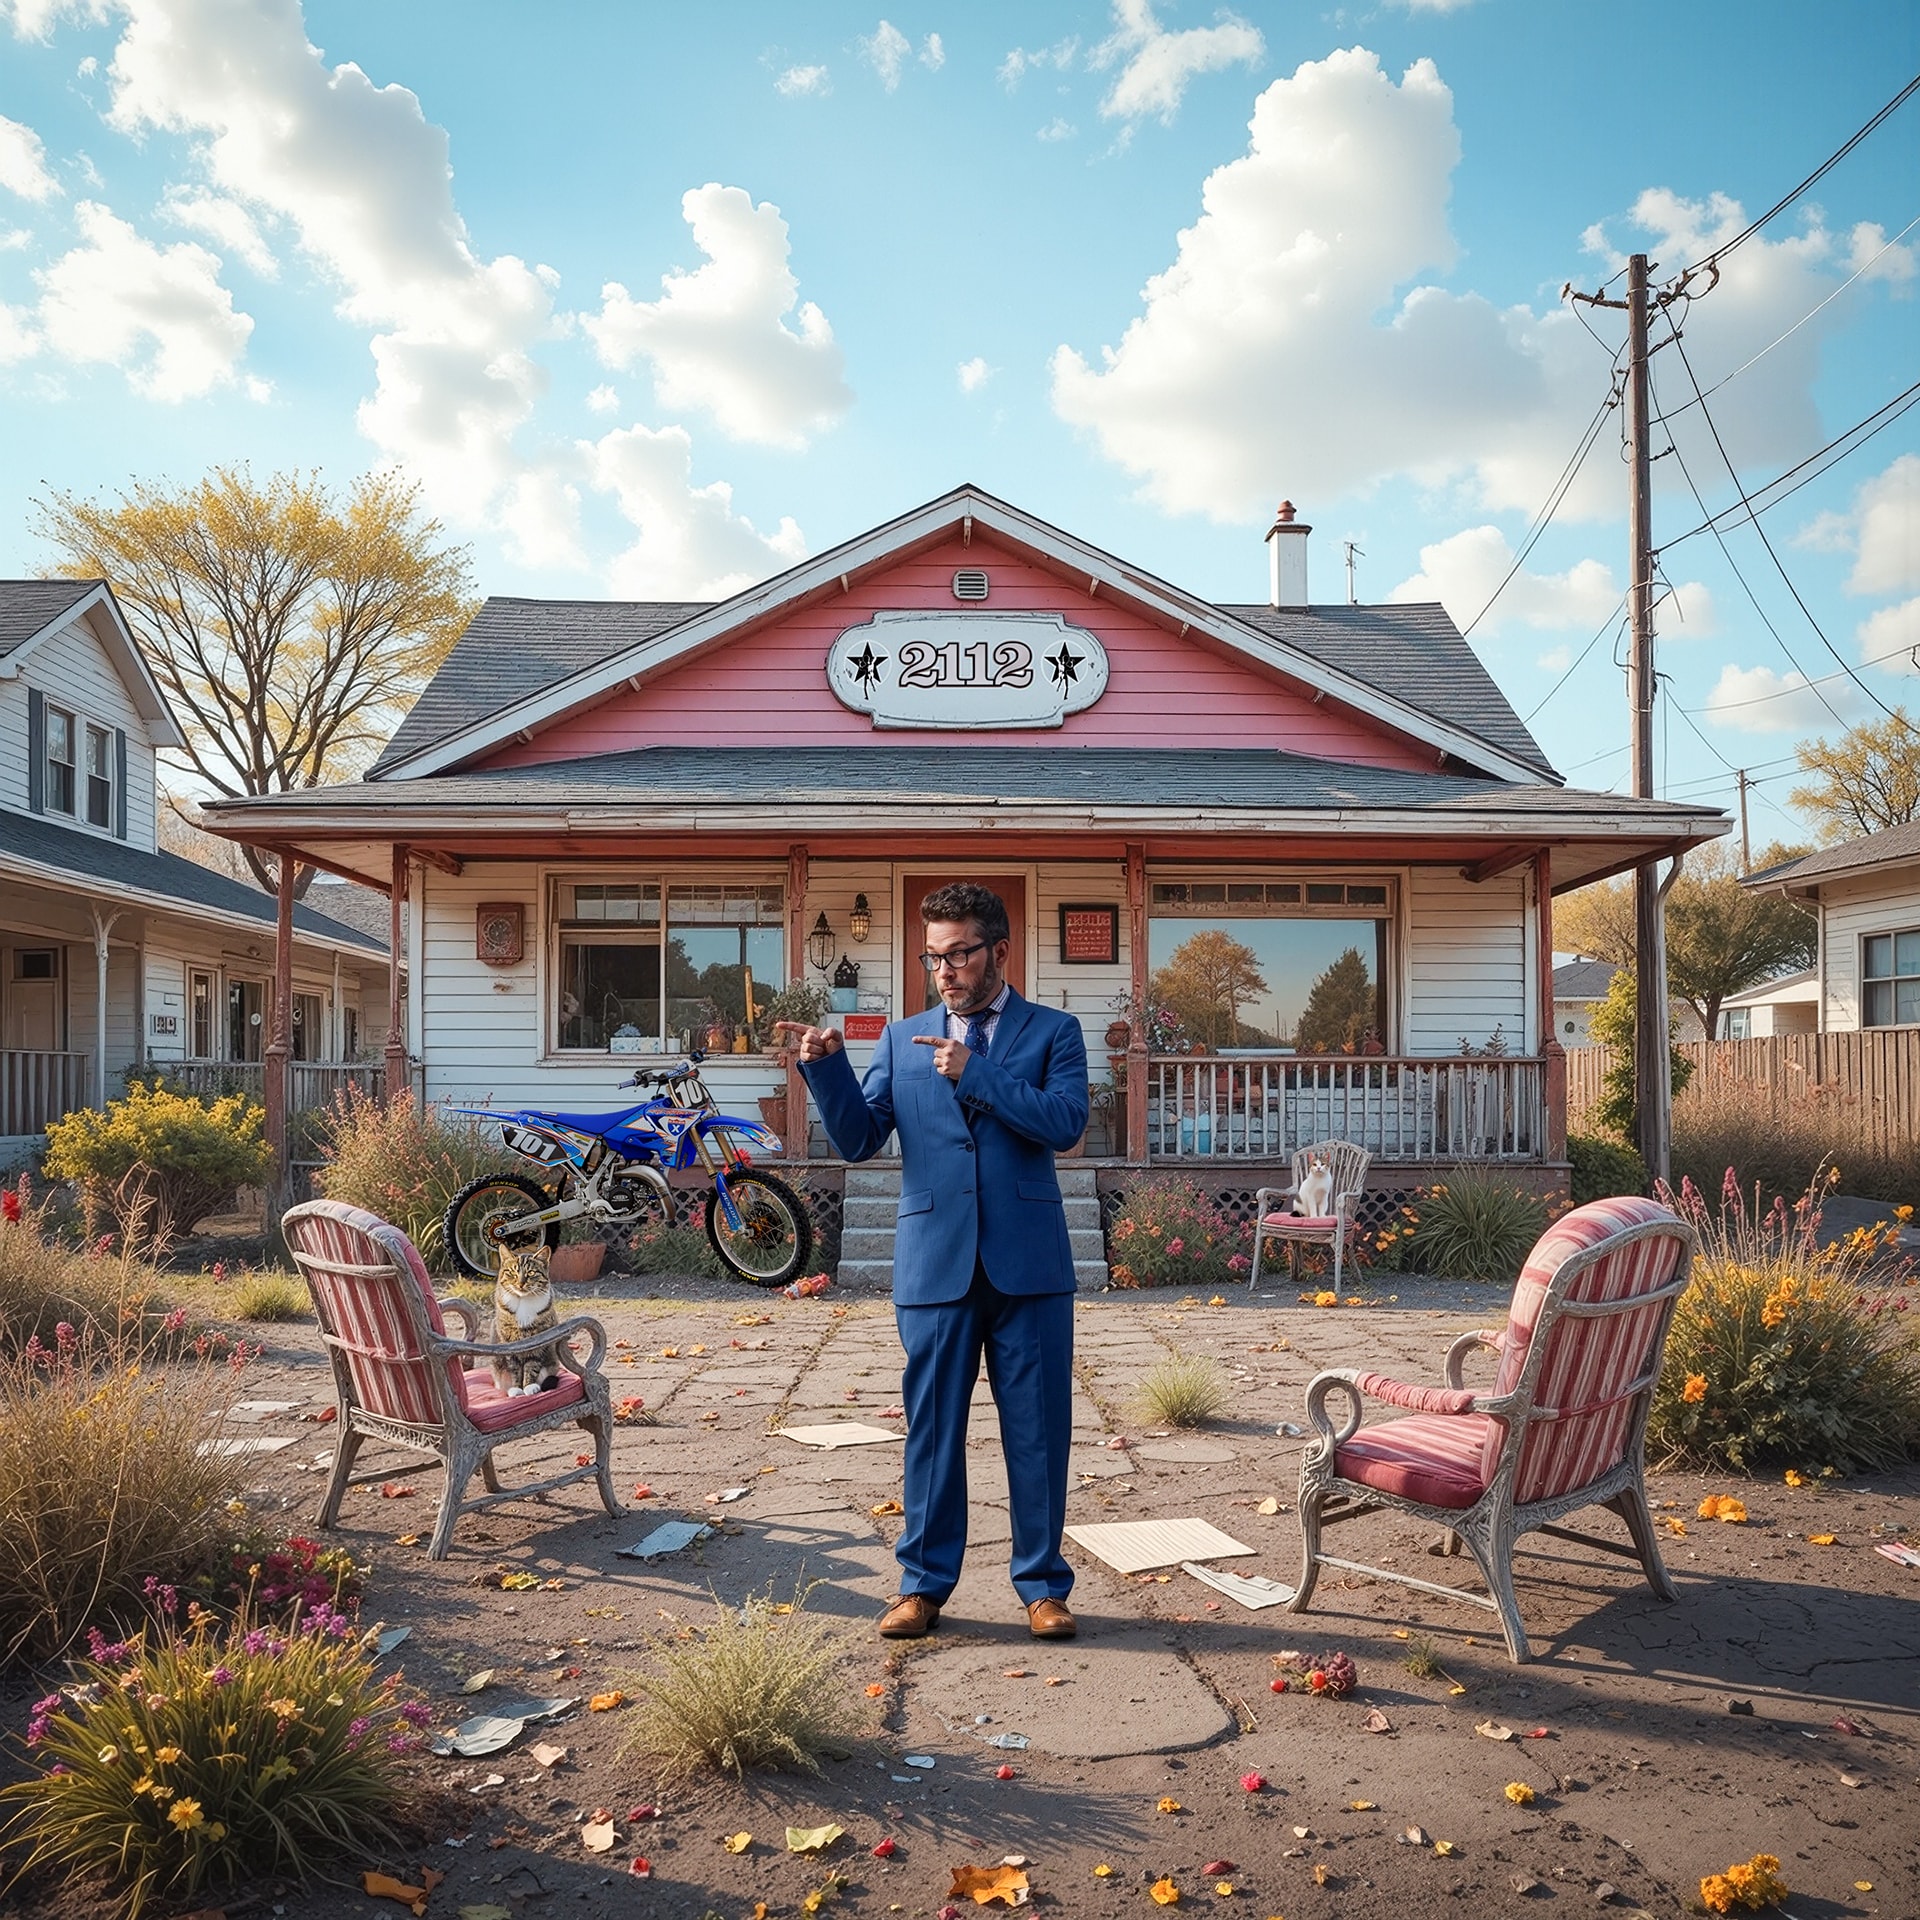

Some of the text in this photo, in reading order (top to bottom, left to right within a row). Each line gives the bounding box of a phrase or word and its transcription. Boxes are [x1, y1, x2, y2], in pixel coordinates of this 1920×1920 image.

[899, 641, 1034, 688] 2112
[510, 1129, 557, 1160] 101
[721, 1192, 738, 1220] DUNLOP
